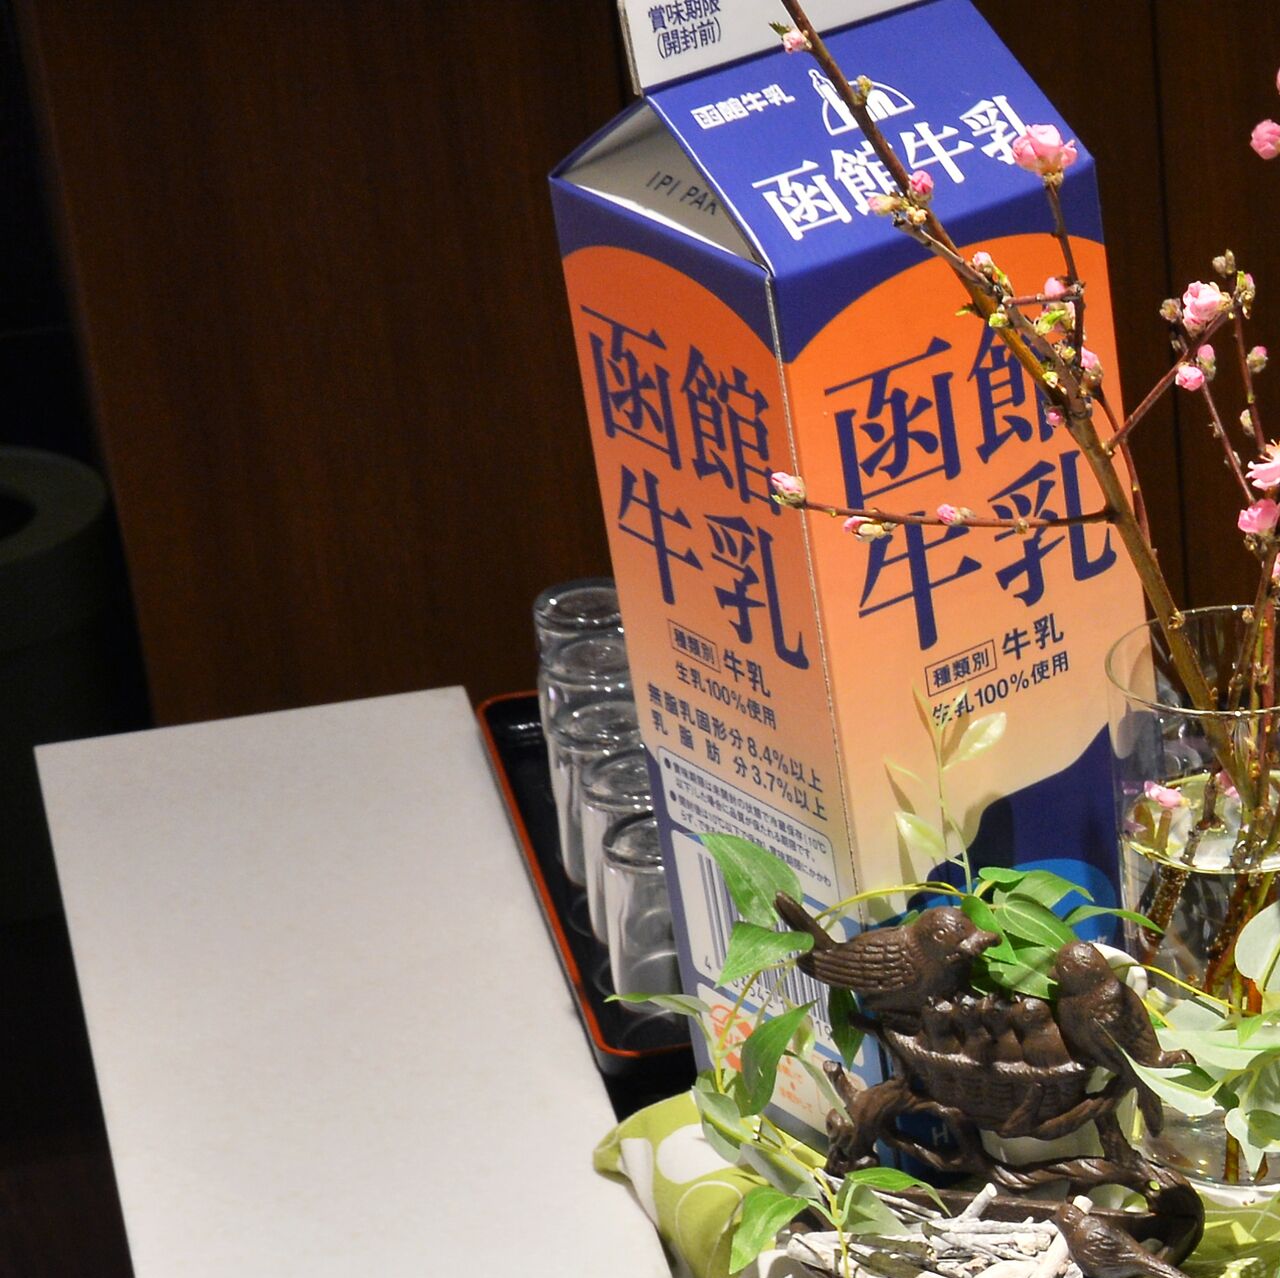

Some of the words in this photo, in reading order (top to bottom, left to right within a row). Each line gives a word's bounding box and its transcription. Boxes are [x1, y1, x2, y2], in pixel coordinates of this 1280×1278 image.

[648, 0, 721, 32] 賞味期限
[690, 84, 796, 130] 函館牛乳
[581, 304, 783, 517] 函館
[618, 464, 810, 670] 牛乳
[858, 448, 1118, 650] 牛乳
[722, 648, 772, 698] 牛乳
[933, 647, 991, 689] 種類別
[1001, 612, 1065, 661] 牛乳
[674, 661, 777, 731] 生乳100%使用
